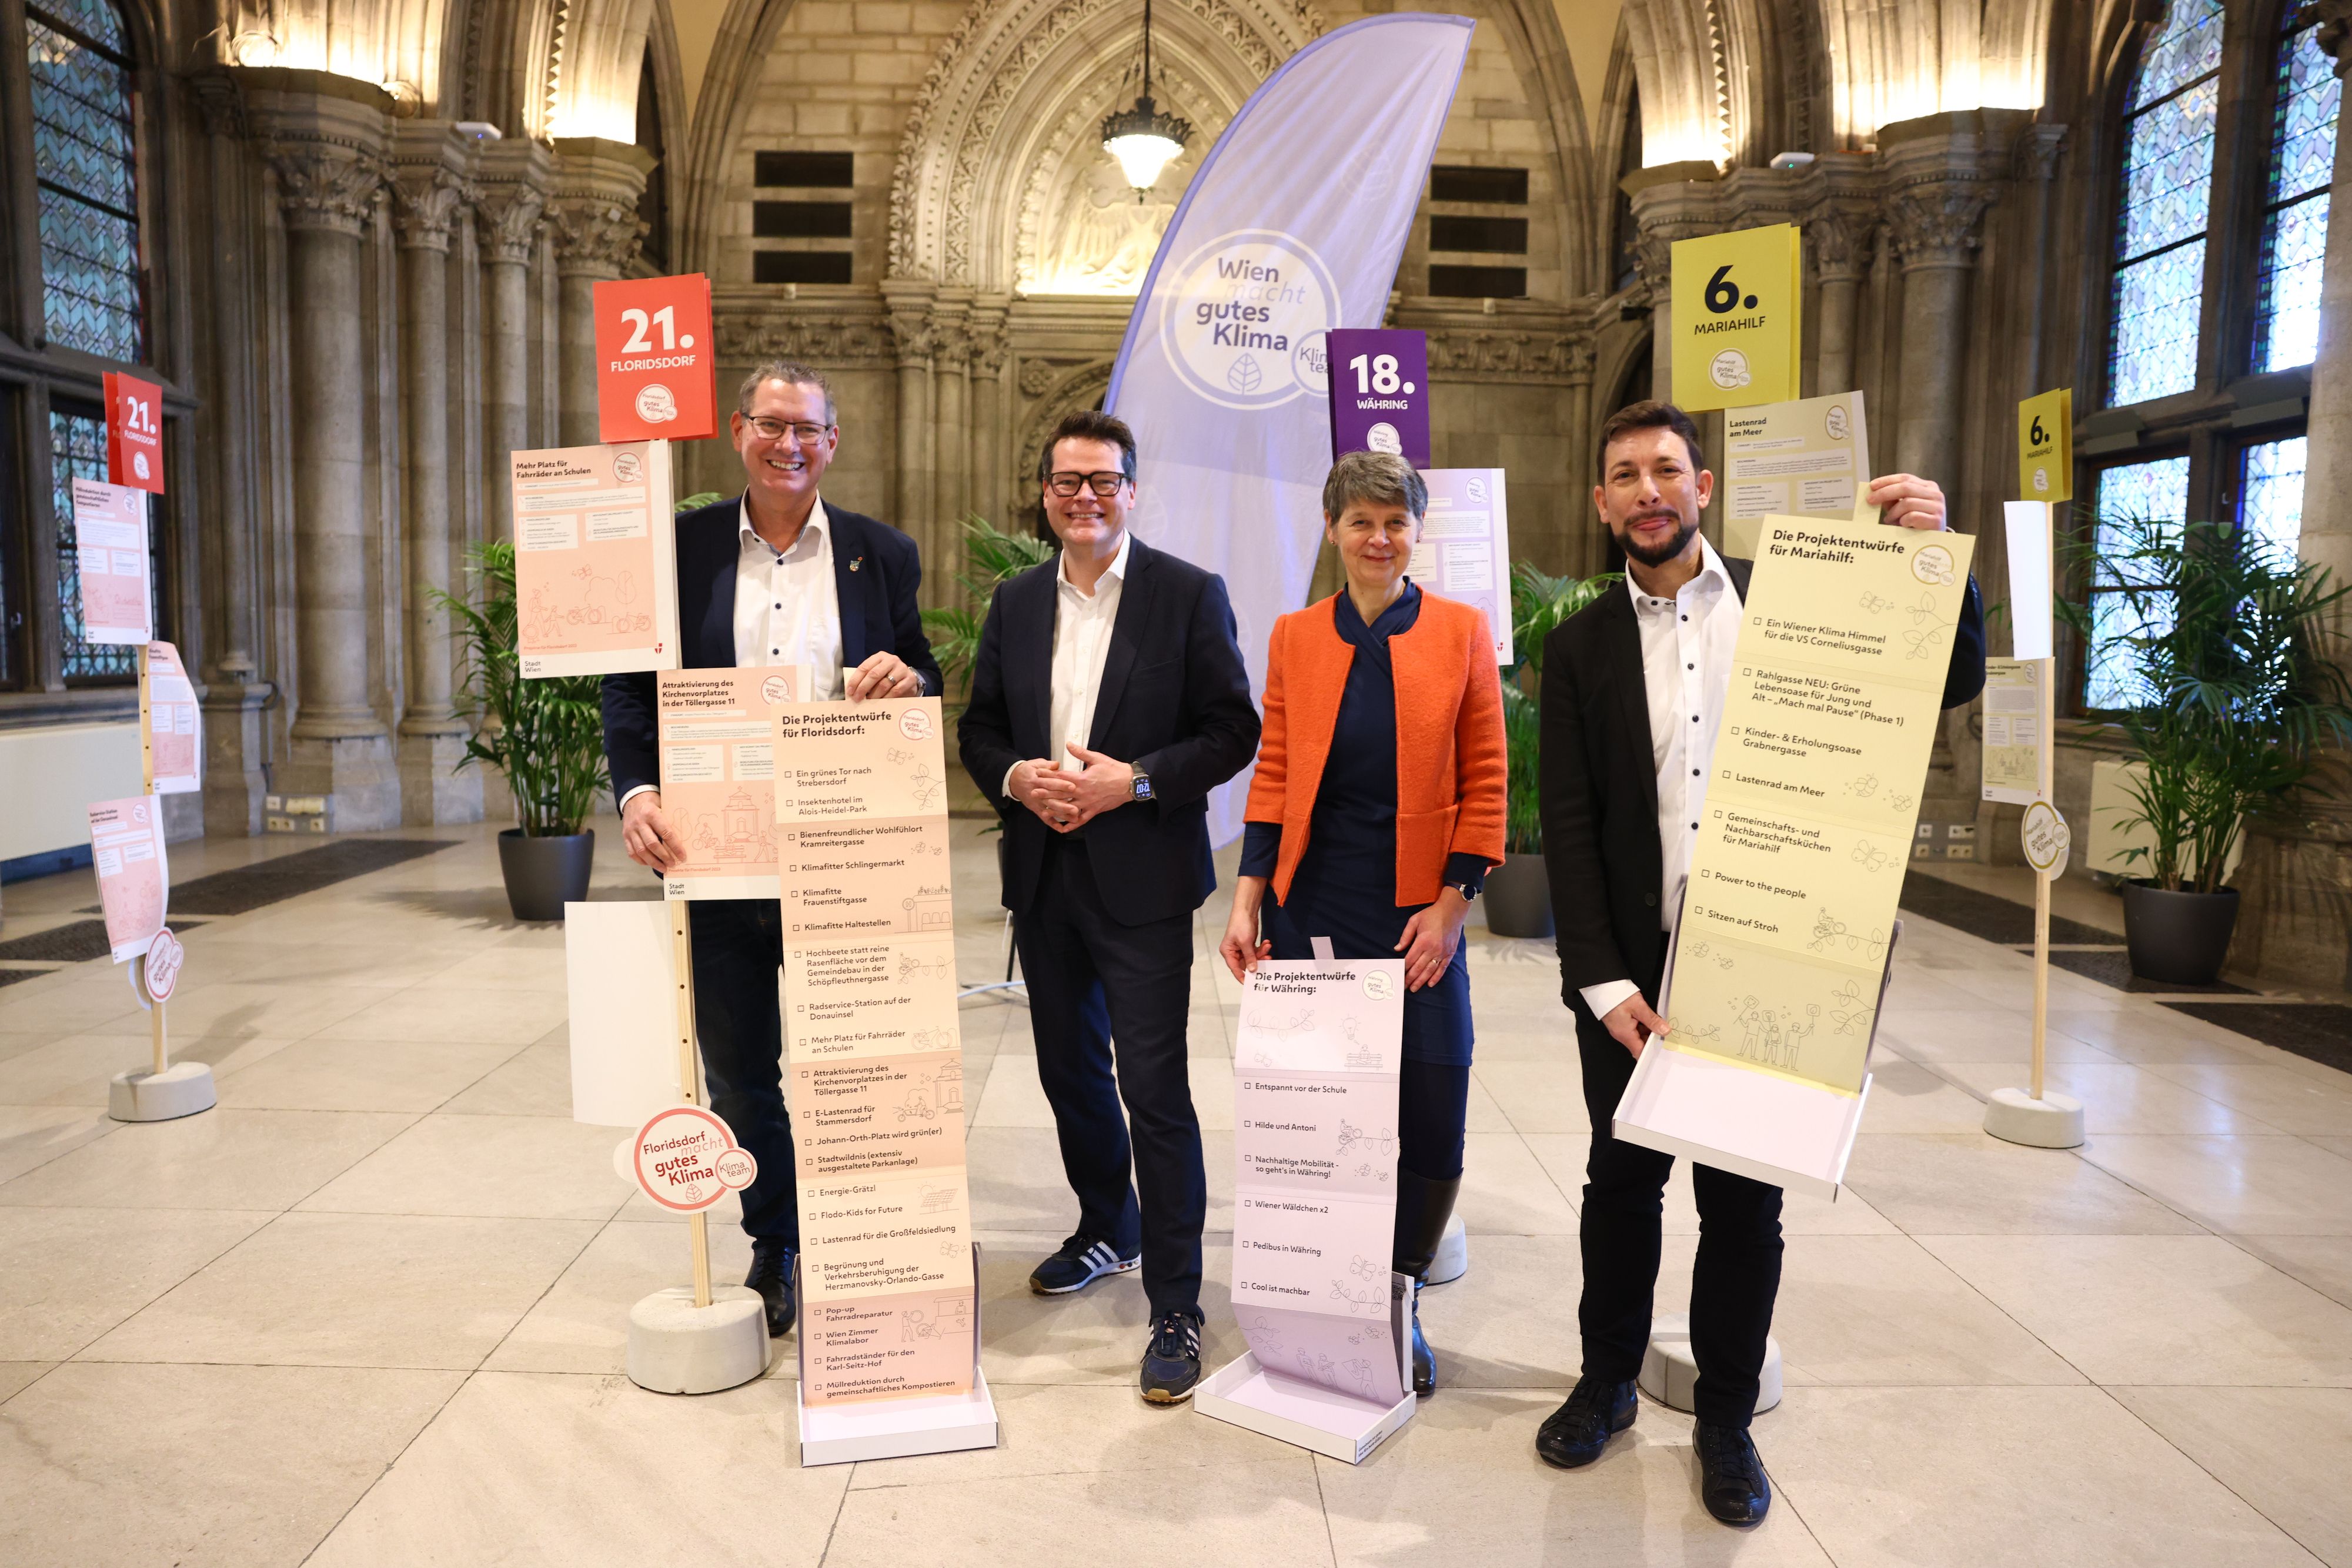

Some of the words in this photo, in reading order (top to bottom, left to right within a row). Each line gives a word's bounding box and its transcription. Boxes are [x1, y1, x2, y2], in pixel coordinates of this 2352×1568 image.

[1218, 258, 1279, 282] Wien
[1225, 281, 1306, 304] macht
[1705, 265, 1758, 313] 6.
[1197, 300, 1269, 325] gutes
[621, 305, 694, 353] 21.
[1694, 316, 1766, 335] MARIAHILF
[1213, 323, 1288, 351] Klima
[611, 355, 696, 372] FLORIDSDORF
[1349, 354, 1415, 394] 18.
[1357, 397, 1408, 410] WÄHRING
[127, 396, 156, 434] 21.
[1729, 417, 1767, 428] Lastenrad
[1742, 428, 1763, 436] Meer
[2030, 415, 2050, 446] 6.
[516, 470, 553, 479] Fahrräder
[563, 467, 592, 476] Schulen
[1773, 529, 1794, 541] Die
[1796, 531, 1905, 554] Projektentwürfe
[1769, 544, 1788, 556] für
[1790, 546, 1854, 564] Mariahilf:
[1766, 618, 1781, 628] Ein
[1783, 620, 1817, 633] Wiener
[1818, 626, 1846, 638] Klima
[1847, 630, 1886, 644] Himmel
[1764, 629, 1779, 639] für
[1779, 632, 1795, 642] die
[1796, 634, 1809, 644] VS
[1810, 636, 1883, 656] Corneliusgasse
[662, 680, 720, 689] Attraktivierung
[662, 689, 729, 698] Kirchenvorplatzes
[684, 698, 727, 707] Töllergasse
[782, 715, 801, 725] Die
[803, 711, 892, 726] Projektentwürfe
[782, 728, 799, 738] für
[801, 725, 865, 737] Floridsdorf:
[796, 770, 809, 778] Ein
[810, 769, 838, 779] grünes
[853, 766, 872, 775] nach
[796, 777, 847, 787] Strebersdorf
[798, 796, 852, 806] Insektenhotel
[799, 805, 867, 815] Alois-Heidel-Park
[1728, 812, 1800, 834] Gemeinschafts-
[1801, 829, 1820, 838] und
[1723, 834, 1737, 844] für
[1738, 837, 1782, 854] Mariahilf
[1725, 823, 1831, 852] Nachbarschaftsküchen
[2031, 831, 2047, 850] gutes
[2037, 838, 2053, 854] Klima
[801, 862, 844, 871] Klimafitter
[845, 858, 905, 870] Schlingermarkt
[1715, 871, 1745, 885] Power
[1745, 879, 1756, 888] to
[1756, 881, 1773, 892] the
[1773, 887, 1806, 900] people
[1708, 910, 1735, 923] Sitzen
[1736, 918, 1753, 927] auf
[1753, 920, 1779, 933] Stroh
[1255, 972, 1272, 981] Die
[1274, 971, 1356, 983] Projektentwürfe
[1254, 982, 1269, 992] für
[1271, 984, 1317, 995] Währing:
[809, 998, 883, 1011] Radservice-Station
[883, 997, 897, 1005] auf
[897, 996, 911, 1004] der
[810, 1009, 854, 1021] Donauinsel
[1255, 1082, 1293, 1092] Entspannt
[1308, 1085, 1321, 1093] der
[1322, 1085, 1347, 1094] Schule
[643, 1131, 706, 1155] Floridsdorf
[816, 1132, 891, 1145] Johann-Orth-Platz
[891, 1129, 909, 1139] wird
[910, 1126, 943, 1139] grün(er)
[681, 1137, 723, 1156] macht
[655, 1155, 698, 1177] gutes
[719, 1161, 745, 1173] Klima
[1255, 1155, 1299, 1168] Nachhaltige
[1300, 1159, 1335, 1169] Mobilität
[669, 1167, 714, 1186] Klima
[727, 1166, 750, 1177] team
[1265, 1166, 1288, 1175] geht's
[1297, 1168, 1331, 1179] Währing!
[819, 1184, 876, 1197] Energie-Grätzl
[821, 1208, 864, 1219] Flodo-Kids
[864, 1207, 877, 1215] for
[878, 1206, 903, 1214] Future
[824, 1261, 868, 1272] Begrünung
[868, 1258, 884, 1267] und
[824, 1268, 905, 1281] Verkehrsberuhigung
[906, 1265, 920, 1273] der
[825, 1273, 944, 1291] Herzmanovsky-Orlando-Gasse
[1251, 1282, 1268, 1291] Cool
[1268, 1284, 1278, 1292] ist
[1278, 1286, 1311, 1296] machbar
[826, 1307, 855, 1315] Pop-up
[826, 1310, 893, 1322] Fahrradreparatur
[826, 1337, 869, 1347] Klimalabor
[826, 1351, 886, 1363] Fahrradständer
[826, 1359, 883, 1372] Karl-Seitz-Hof
